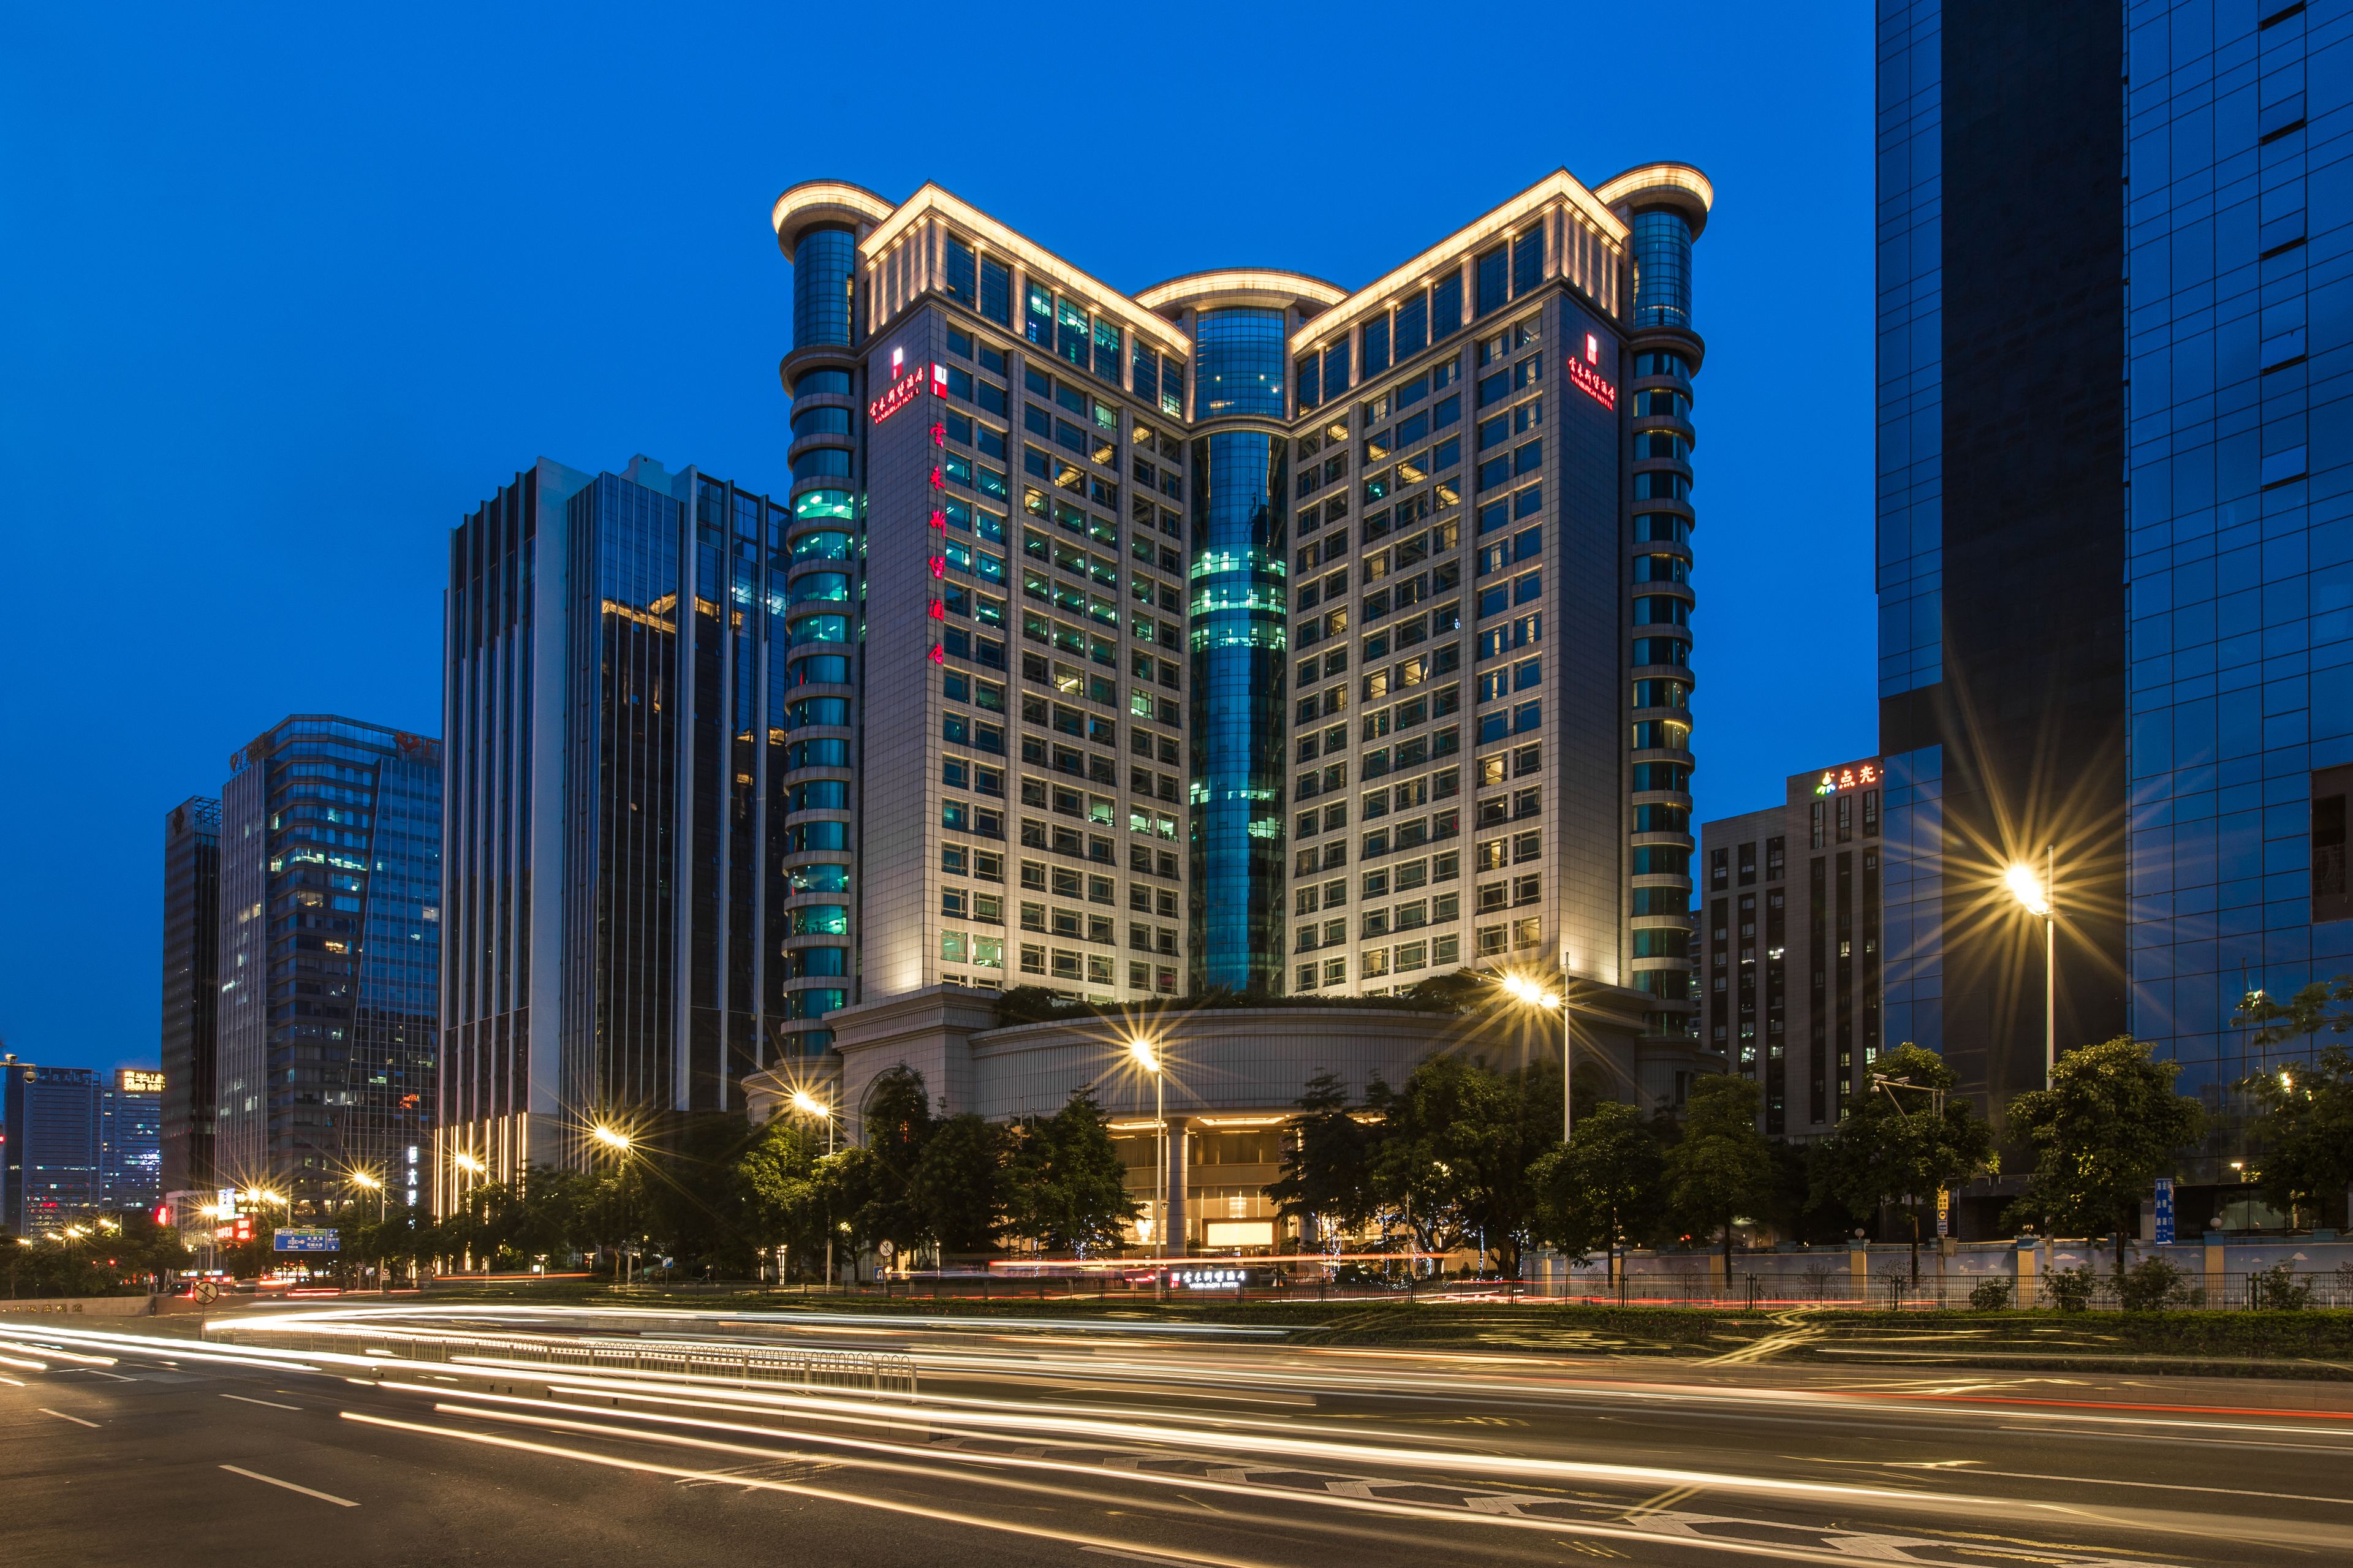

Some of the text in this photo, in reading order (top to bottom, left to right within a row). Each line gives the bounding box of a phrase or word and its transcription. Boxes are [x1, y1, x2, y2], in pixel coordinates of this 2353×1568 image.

[903, 387, 920, 406] HOTL
[1571, 374, 1613, 412] VANBURGH HOTEL
